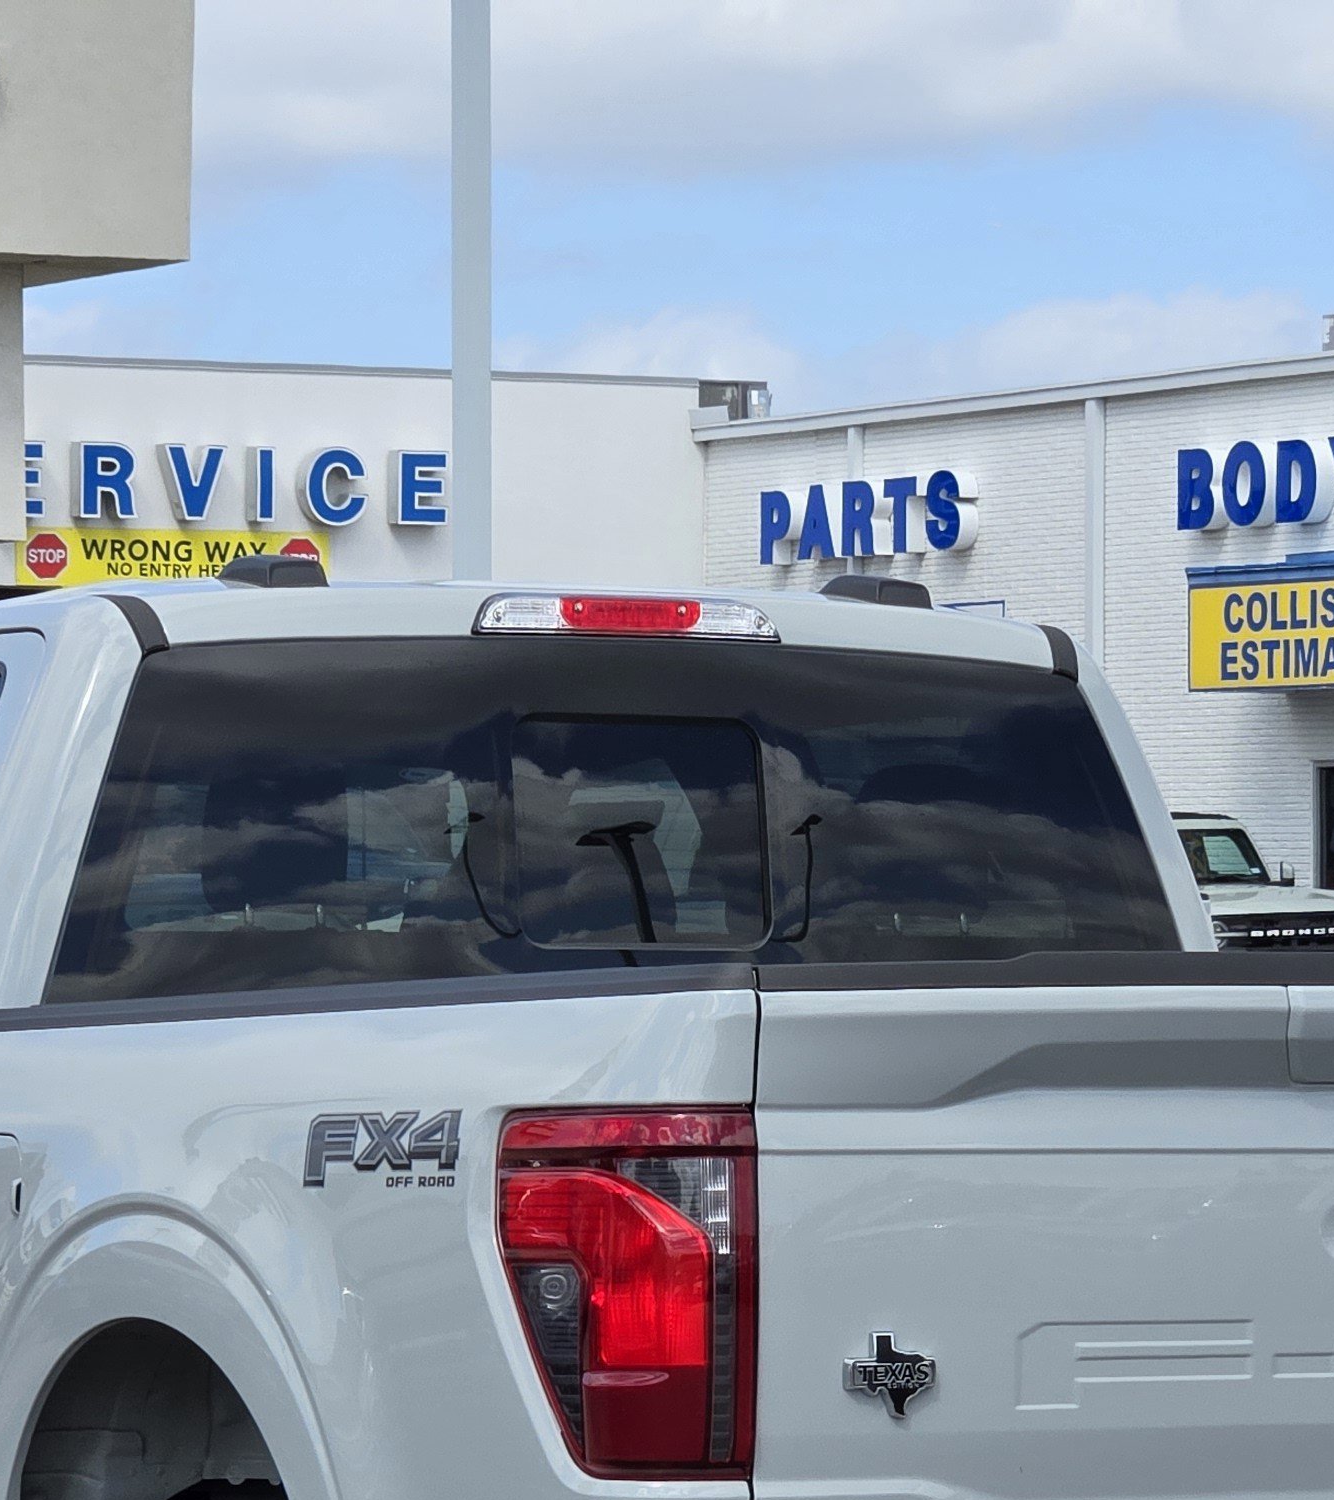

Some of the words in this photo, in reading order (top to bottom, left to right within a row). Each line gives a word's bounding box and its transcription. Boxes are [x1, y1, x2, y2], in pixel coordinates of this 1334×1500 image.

[760, 470, 963, 566] PARTS
[28, 548, 66, 564] STOP
[81, 538, 193, 562] WRONG
[204, 541, 267, 562] WAY
[107, 562, 133, 576] NO
[139, 563, 193, 579] ENTRY
[199, 564, 227, 578] HE
[303, 1109, 463, 1188] FX4
[386, 1176, 414, 1188] OFF
[418, 1176, 455, 1188] ROAD
[858, 1363, 930, 1382] TEXAS
